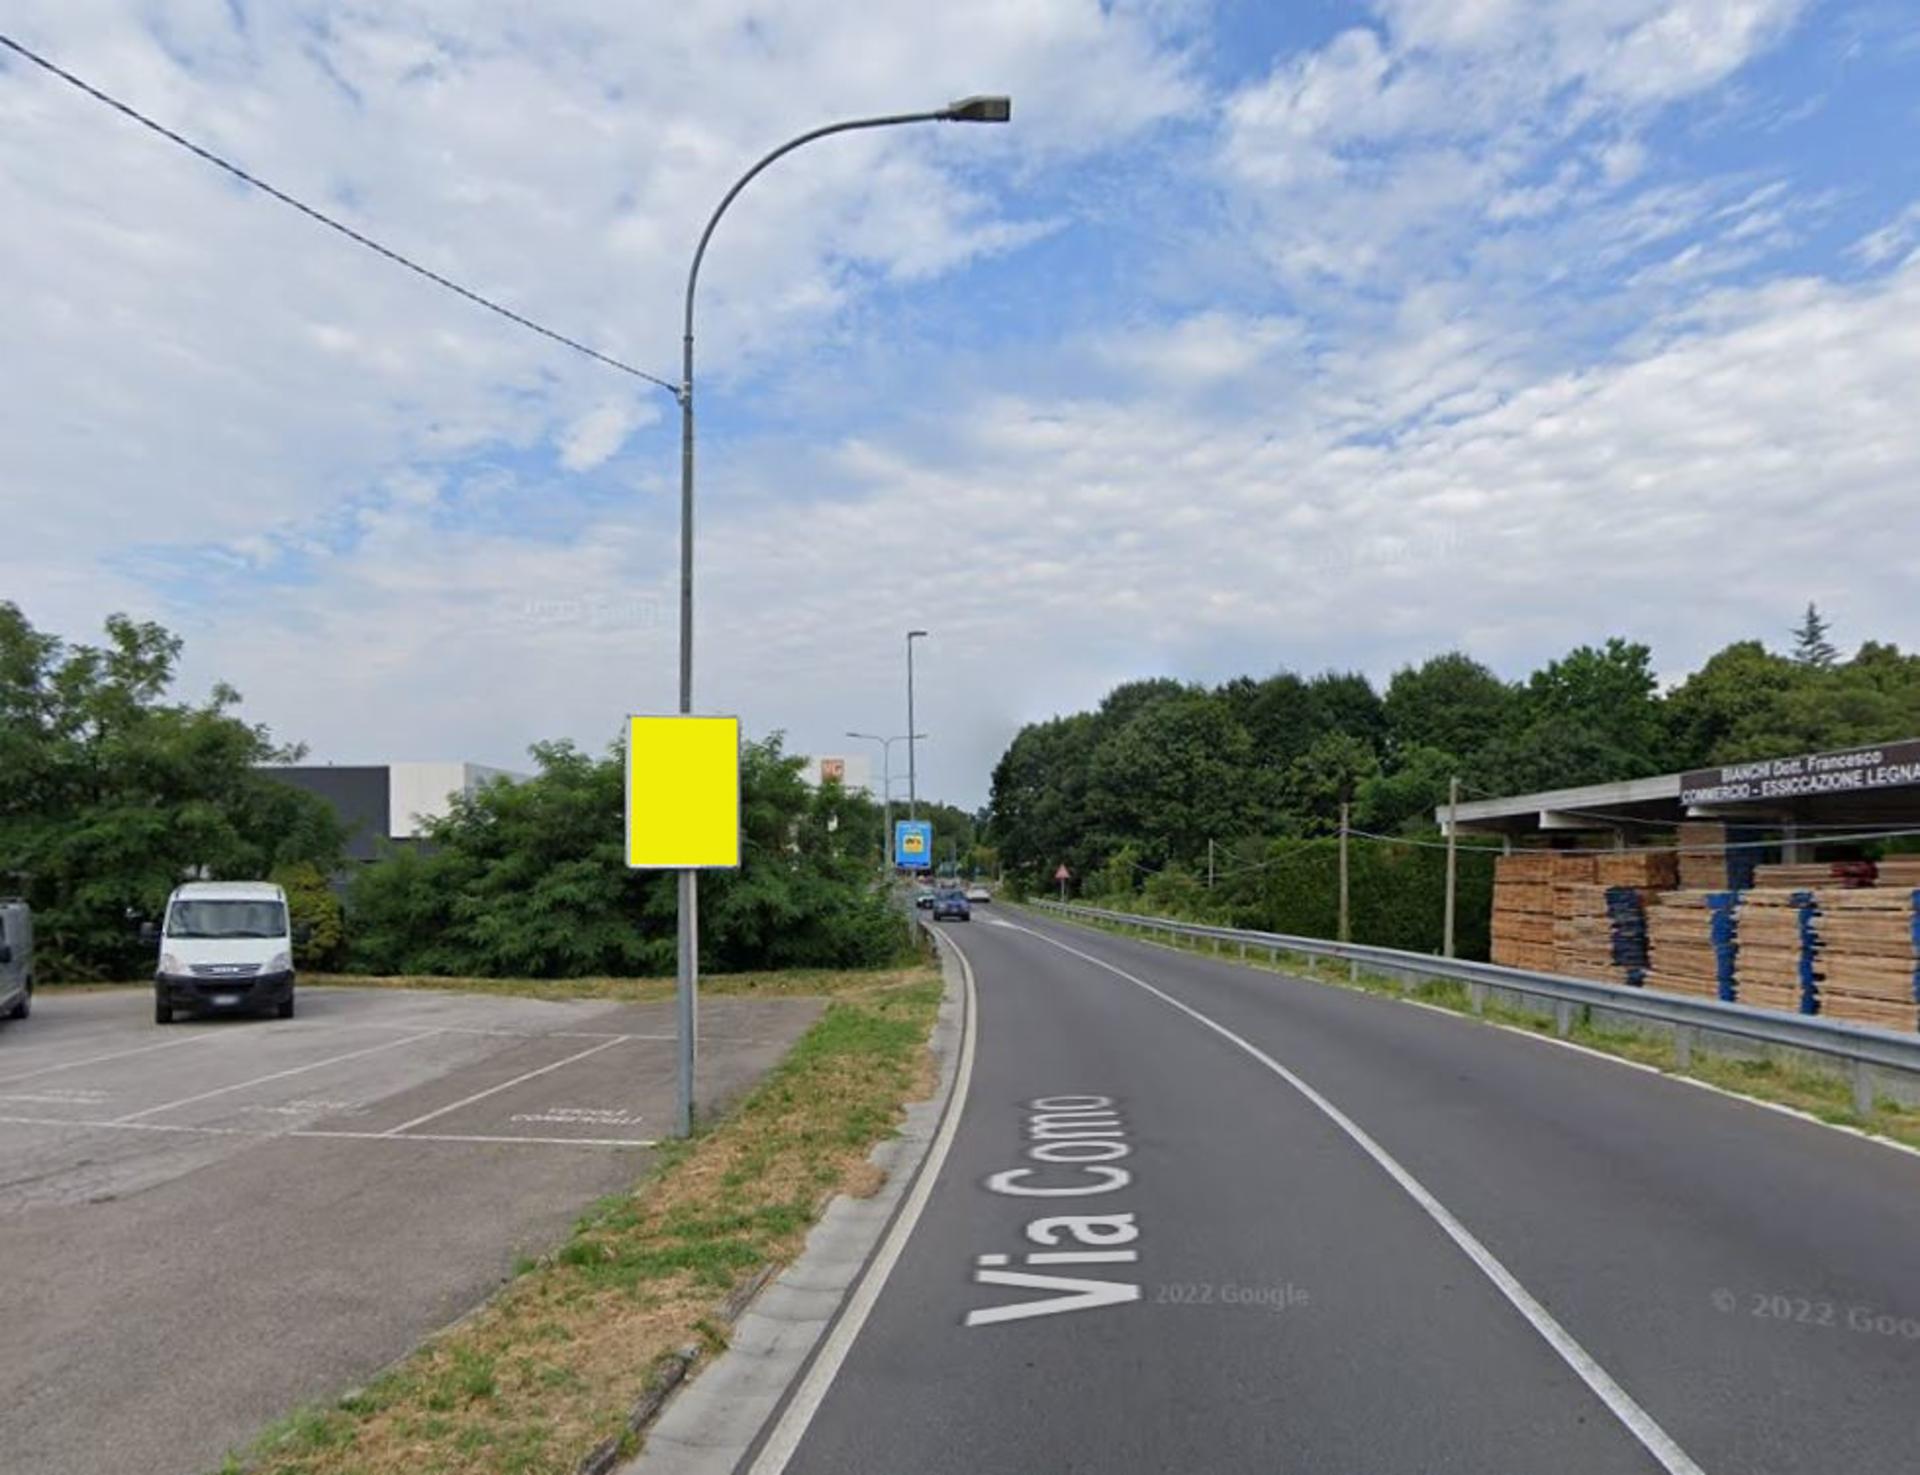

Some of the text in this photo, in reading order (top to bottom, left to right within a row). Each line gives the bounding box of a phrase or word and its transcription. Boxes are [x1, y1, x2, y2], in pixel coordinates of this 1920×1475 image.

[1721, 763, 1770, 783] BIANCHI
[1807, 751, 1883, 772] Francesco
[1682, 784, 1750, 804] COMMERCIO
[1761, 770, 1864, 797] ESSICCAZIONE
